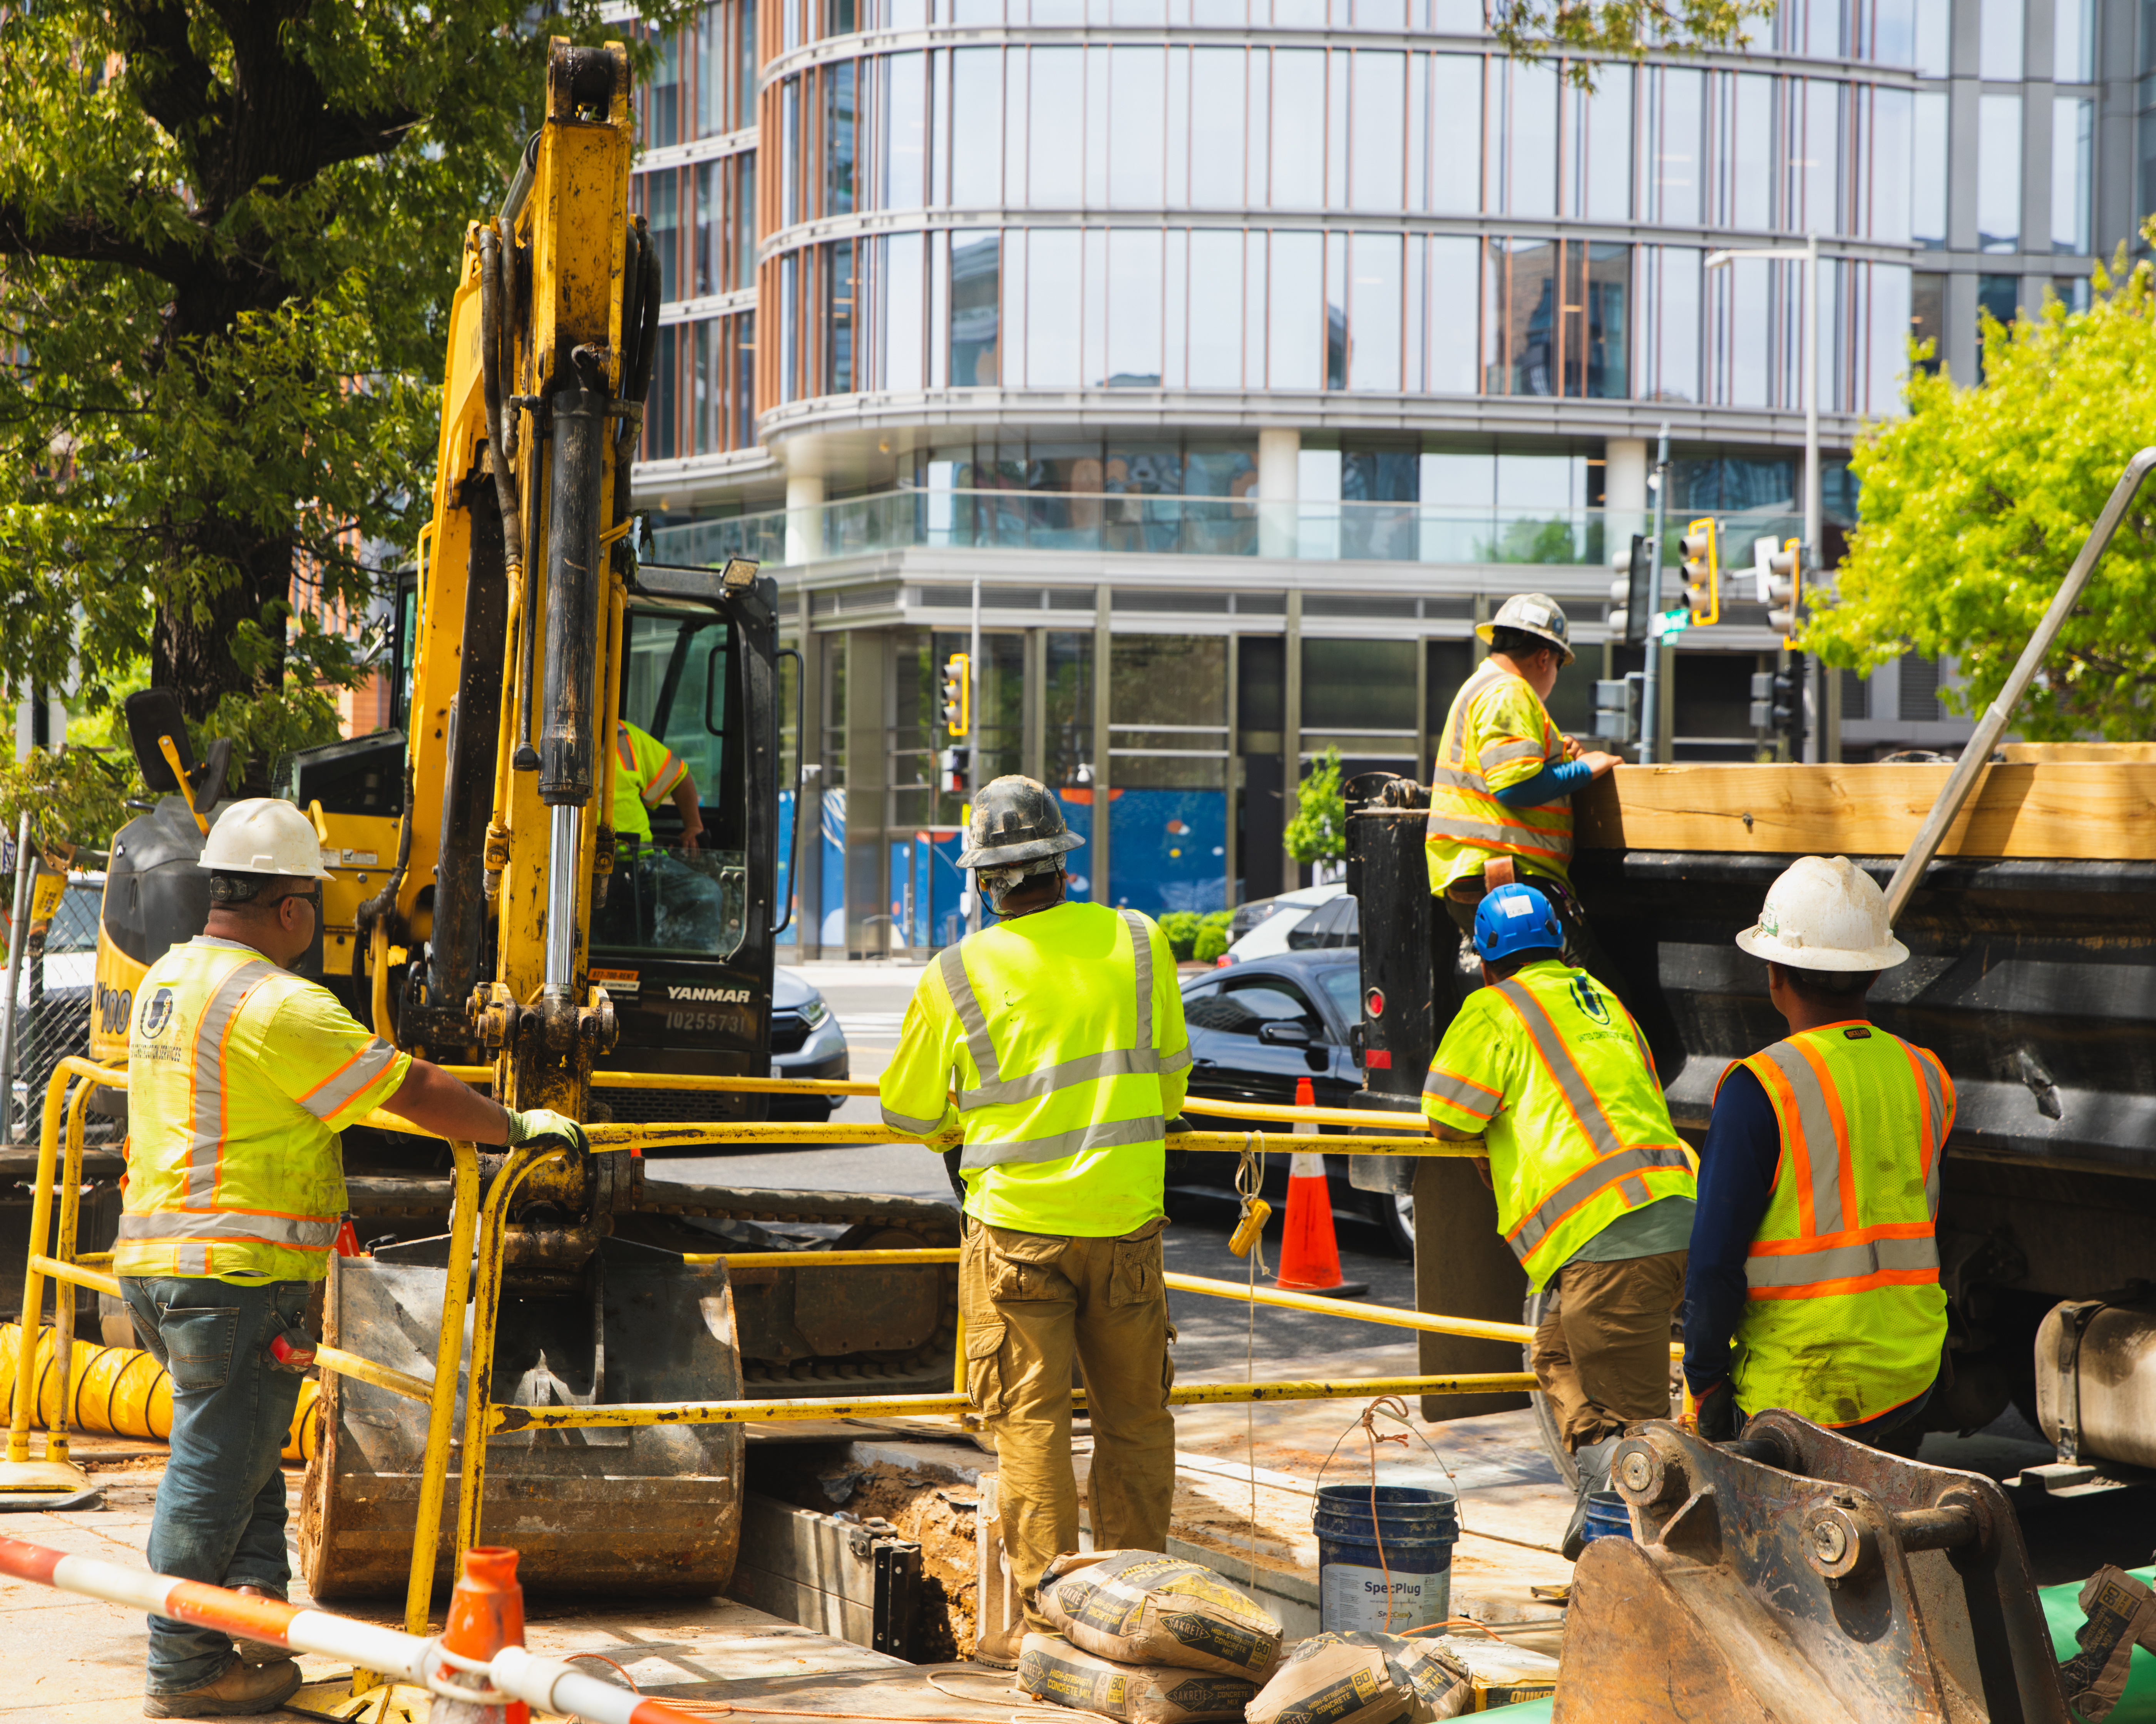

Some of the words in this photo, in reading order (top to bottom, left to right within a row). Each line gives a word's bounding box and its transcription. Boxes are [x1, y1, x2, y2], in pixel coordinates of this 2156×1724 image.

[667, 986, 751, 1003] YANMAR
[666, 1011, 745, 1033] 10255731
[159, 1045, 181, 1062] SERVICES
[1364, 1581, 1421, 1596] SpecPlug
[2102, 1586, 2121, 1606] 80
[1168, 1618, 1205, 1639] SAKRETE
[2088, 1616, 2112, 1653] CONCRETE
[1211, 1627, 1255, 1648] HIGH-STRENGTH
[1214, 1636, 1247, 1654] CONCRETE
[2101, 1632, 2114, 1648] MIX
[1222, 1647, 1235, 1657] MIX
[1255, 1641, 1269, 1655] 80
[1049, 1668, 1093, 1688] HIGH-STRENGTH
[1111, 1677, 1123, 1691] 80
[1354, 1672, 1370, 1687] 80
[1047, 1679, 1078, 1697] CONCRETE
[1079, 1689, 1091, 1699] MIX
[1173, 1689, 1207, 1701] SAKRETE
[1308, 1682, 1354, 1710] HIGH-STRENGTH
[1316, 1692, 1352, 1715] CONCRETE
[1330, 1705, 1345, 1716] MIX
